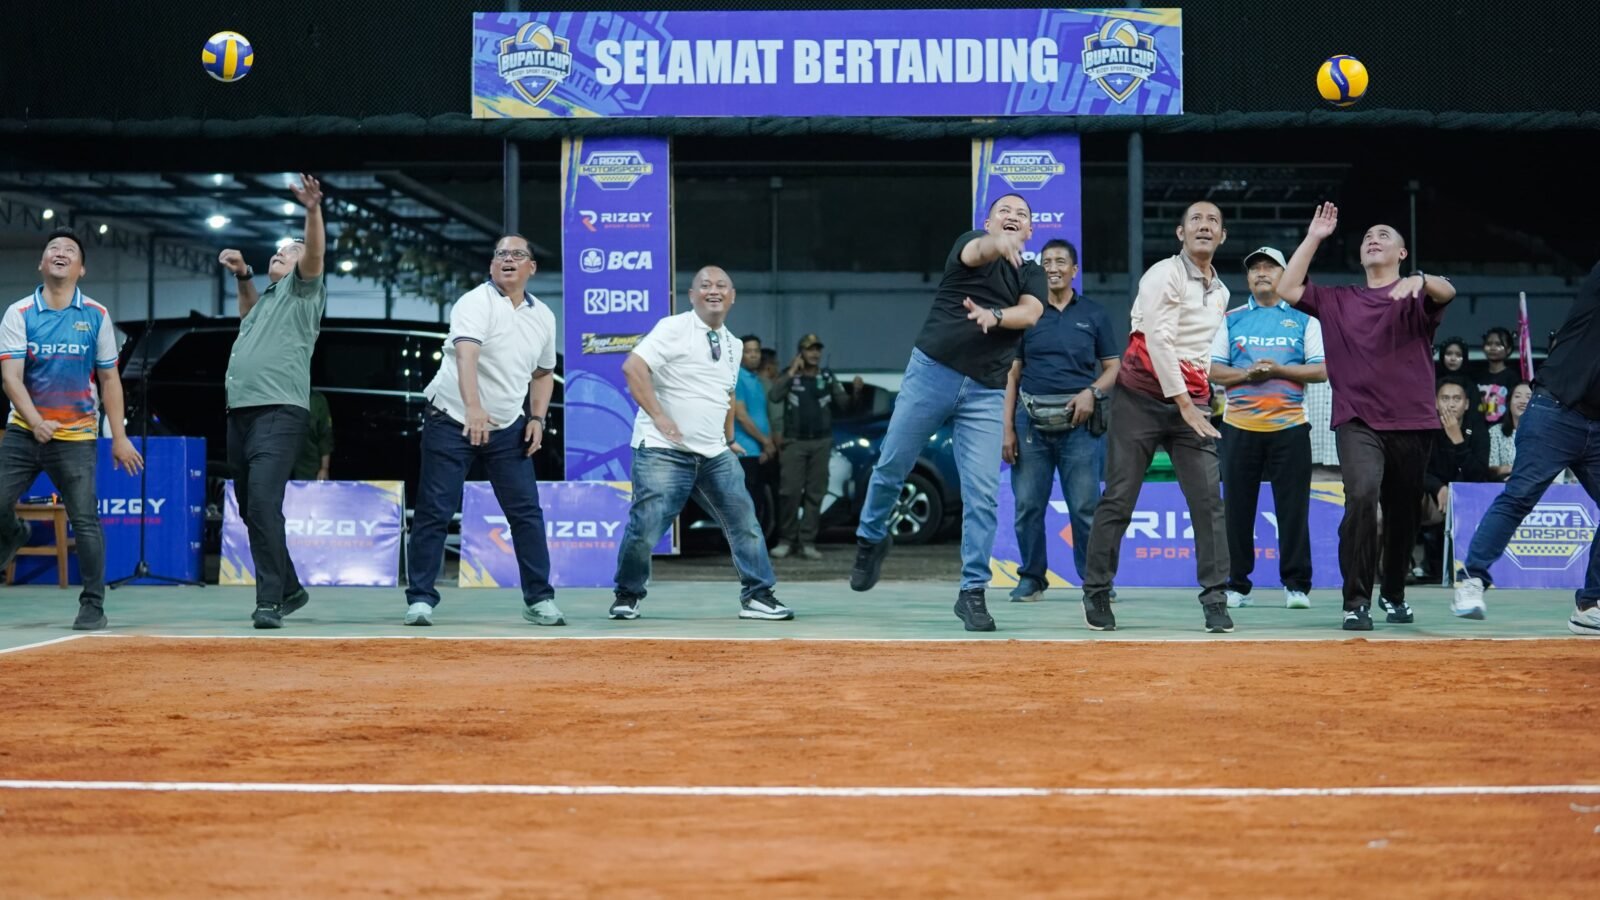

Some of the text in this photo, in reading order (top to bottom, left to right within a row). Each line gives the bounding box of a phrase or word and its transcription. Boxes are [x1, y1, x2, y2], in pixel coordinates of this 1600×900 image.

[502, 51, 570, 71] BUPATI CUP
[595, 38, 1058, 85] SELAMAT BERTANDING
[1085, 48, 1154, 68] BUPATI CUP
[993, 165, 1059, 173] MOTORSPORT
[601, 212, 652, 223] RIZQY
[1031, 212, 1065, 223] ZQY
[607, 251, 653, 270] BCA
[611, 290, 649, 312] BRI
[41, 343, 90, 355] RIZQY
[1248, 336, 1299, 347] RIZQY
[285, 520, 379, 536] RIZQY
[547, 521, 621, 538] IZQY
[1135, 548, 1195, 558] SPOR
